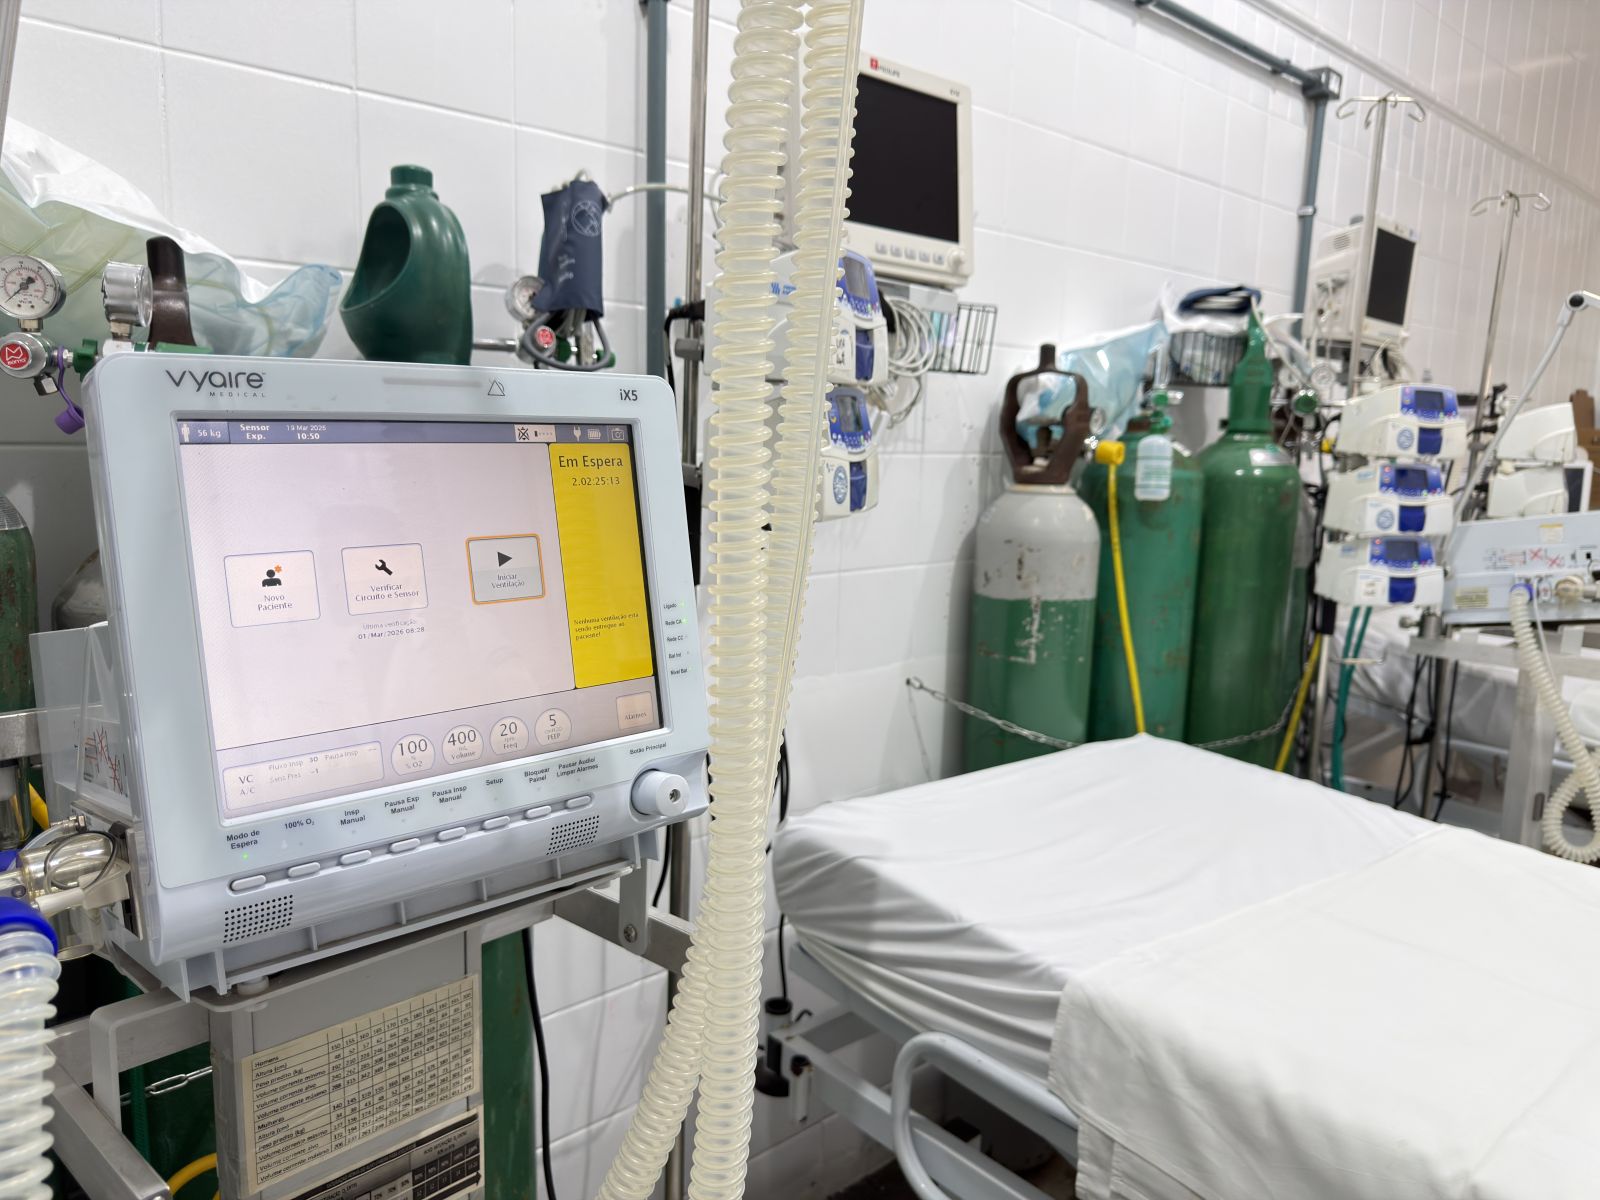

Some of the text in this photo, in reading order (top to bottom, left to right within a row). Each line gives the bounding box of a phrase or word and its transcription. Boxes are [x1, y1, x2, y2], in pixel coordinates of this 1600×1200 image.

[165, 370, 264, 392] vyaire
[619, 389, 638, 401] iX5
[211, 429, 221, 438] kg
[246, 433, 266, 441] Exp.
[558, 455, 624, 469] Em Espera
[370, 584, 402, 592] Verificar
[264, 594, 285, 602] Novo
[355, 593, 386, 602] Circuito
[394, 590, 420, 598] Sensor
[258, 602, 293, 611] Paciente
[549, 714, 557, 727] 5
[500, 721, 518, 737] 20
[447, 729, 477, 747] 400
[398, 738, 428, 756] 100
[645, 741, 667, 752] Principal
[451, 751, 476, 760] Volume
[556, 763, 599, 778] Limpar Alarmes
[558, 761, 577, 770] Pausar
[524, 767, 550, 777] Bloquear
[238, 774, 254, 784] VC
[485, 778, 504, 786] Setup
[529, 775, 547, 784] Painel
[432, 785, 467, 798] Pausa Insp
[384, 796, 420, 808] Pausa Exp
[438, 794, 462, 804] Manual
[344, 808, 360, 817] Insp
[390, 804, 415, 814] Manual
[284, 820, 304, 830] 100%
[340, 815, 366, 826] Manual
[226, 829, 260, 842] Modo de
[230, 839, 258, 850] Espera
[254, 1055, 279, 1068] Homens
[255, 1067, 272, 1078] Altura
[255, 1078, 269, 1088] Peso
[270, 1071, 291, 1083] predito
[255, 1086, 278, 1099] Volume
[278, 1077, 303, 1090] corrente
[255, 1096, 278, 1109] Volume
[279, 1087, 303, 1100] corrente
[304, 1081, 316, 1090] alvo
[256, 1106, 278, 1120] Volume
[279, 1097, 303, 1111] corrente
[257, 1115, 284, 1130] Mulheres
[258, 1129, 275, 1140] Altura
[272, 1132, 293, 1145] predito
[258, 1147, 280, 1161] Volume
[281, 1137, 305, 1151] corrente
[259, 1157, 281, 1171] Volume
[282, 1147, 305, 1162] corrente
[307, 1141, 318, 1151] alvo
[260, 1167, 281, 1181] Volume
[282, 1157, 306, 1172] corrente
